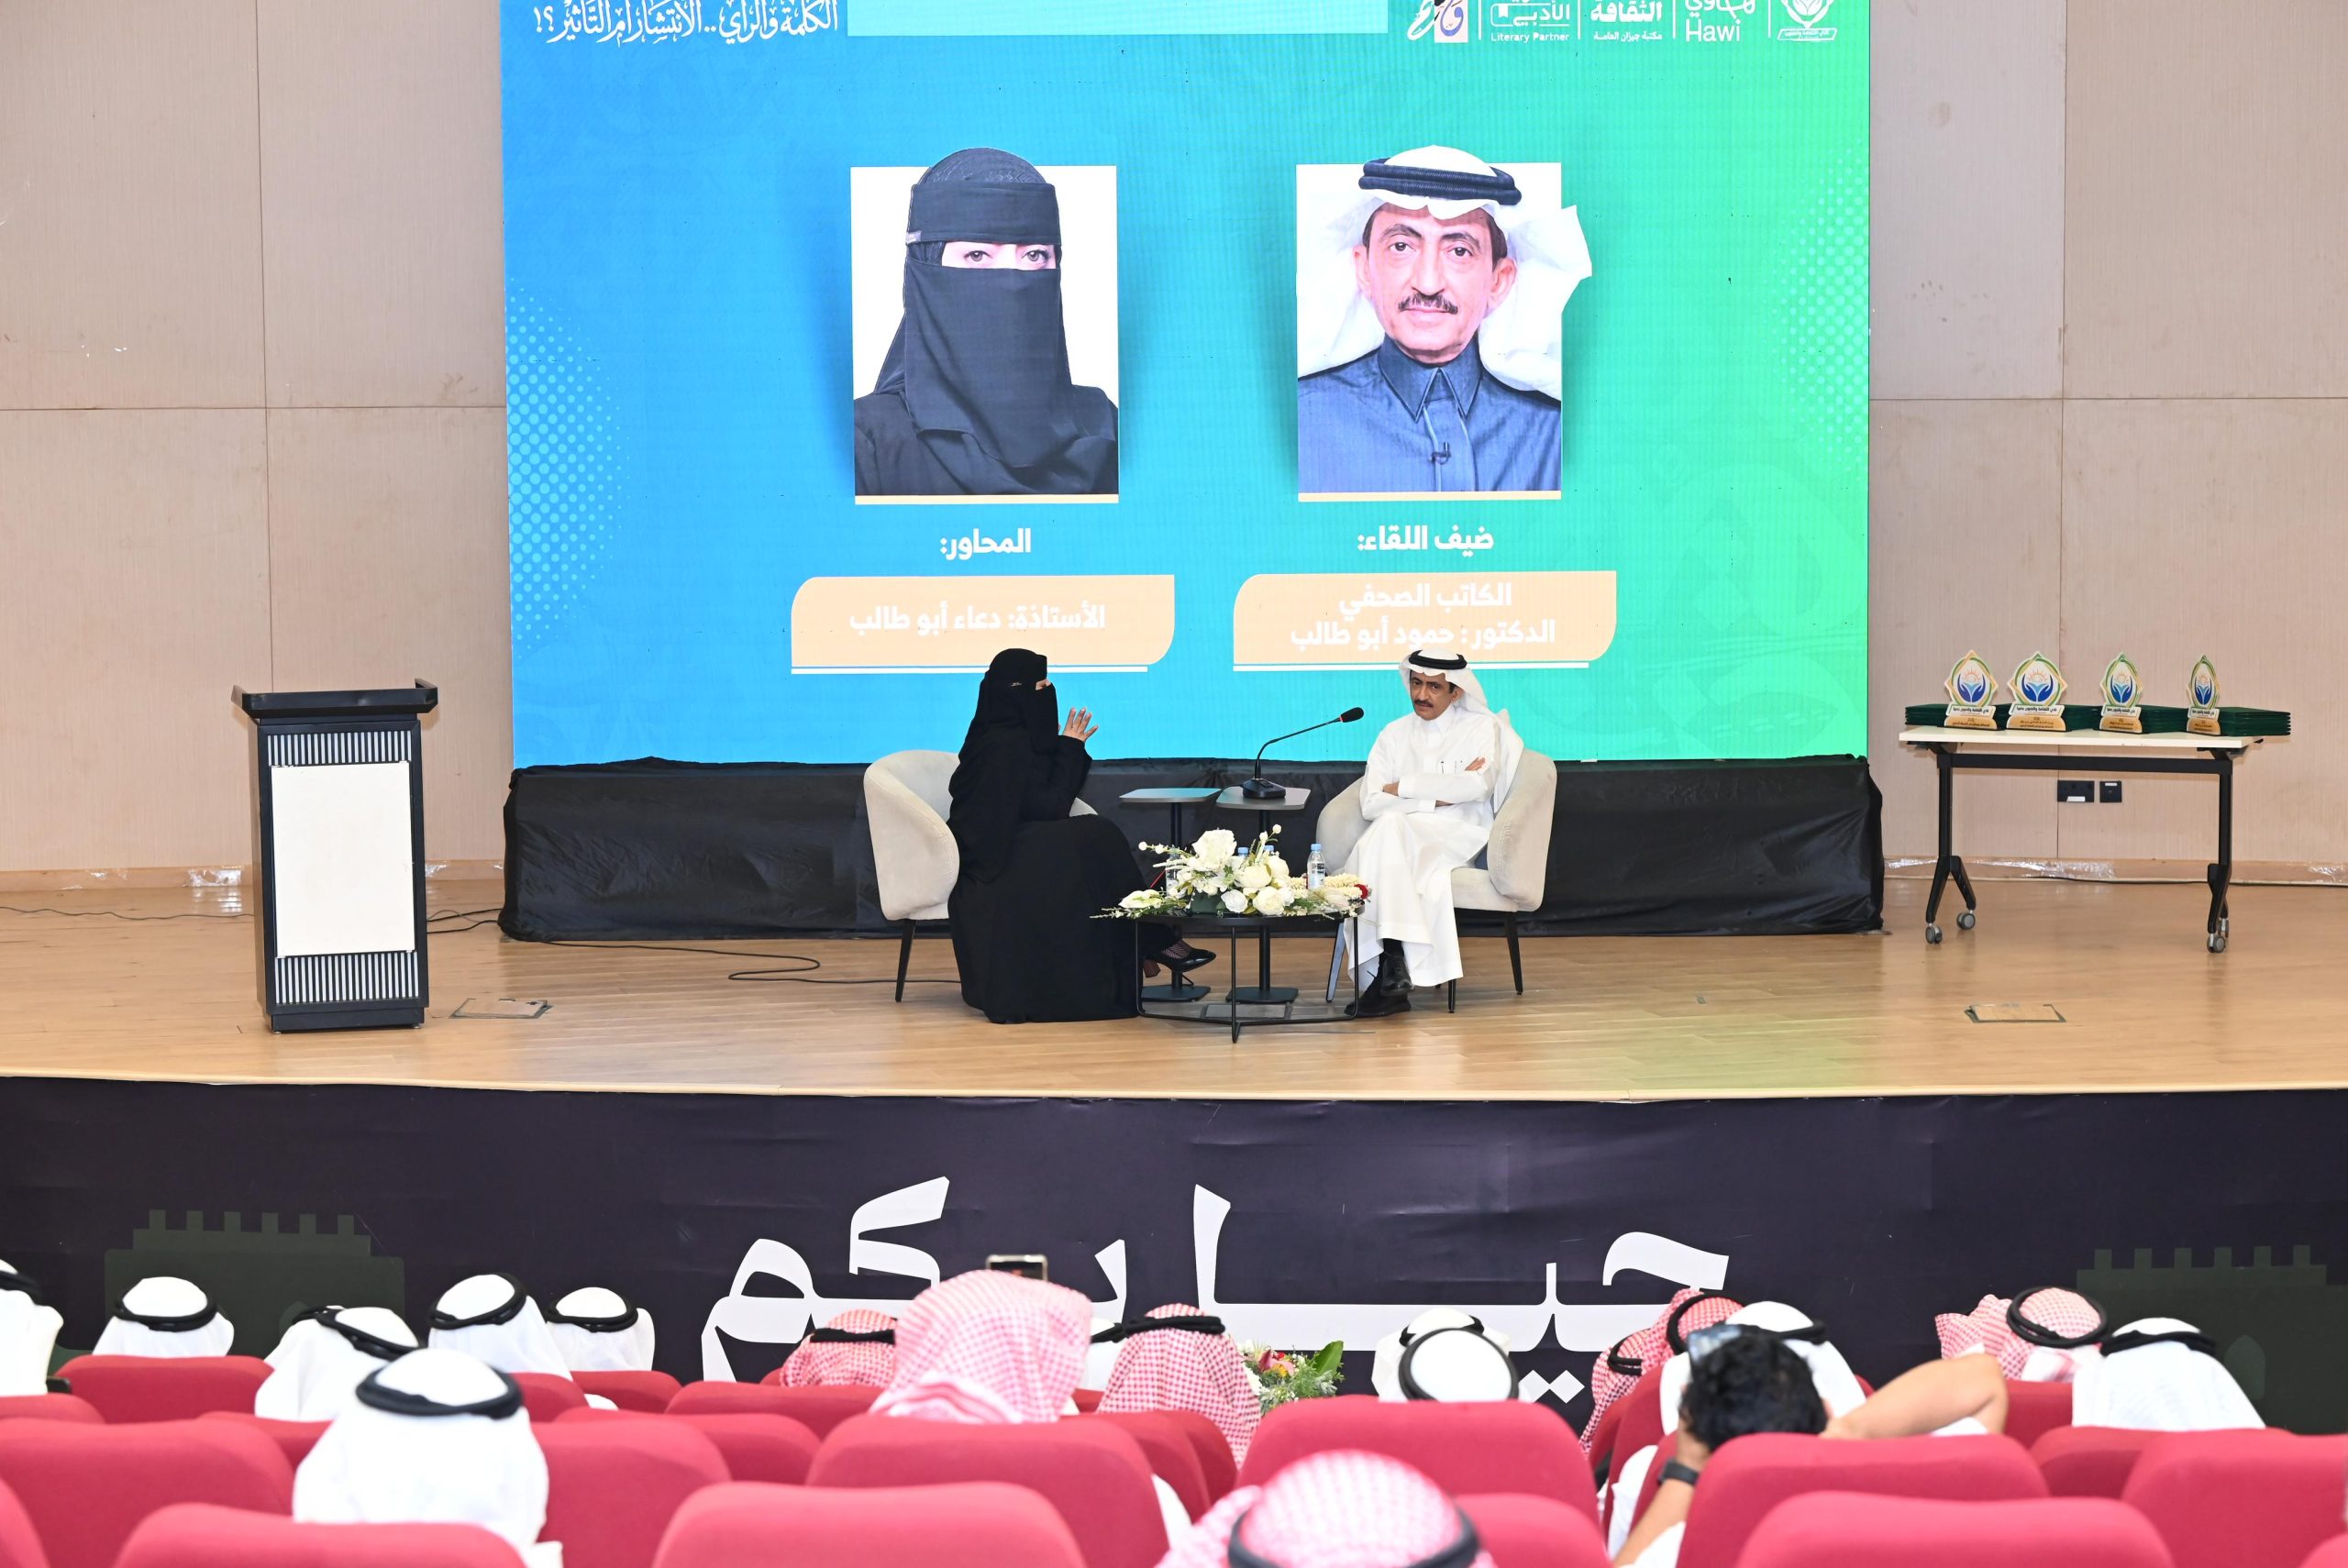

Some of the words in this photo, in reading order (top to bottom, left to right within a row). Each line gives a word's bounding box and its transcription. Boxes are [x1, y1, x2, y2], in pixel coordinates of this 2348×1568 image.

[1490, 32, 1531, 43] Literary
[1533, 32, 1570, 41] Partner
[1685, 18, 1742, 42] Hawi
[940, 527, 1031, 560] المحاور:
[1357, 525, 1428, 551] اللقاء:
[1433, 525, 1494, 557] ضيف
[1339, 582, 1431, 621] الصحفي
[1436, 582, 1512, 613] الكاتب
[849, 605, 911, 635] طالب
[917, 601, 947, 635] أبو
[954, 604, 1001, 630] دعاء
[1008, 601, 1105, 630] الأستاذة:
[1290, 621, 1351, 650] طالب
[1357, 615, 1390, 652] أبو
[1393, 625, 1455, 650] حمود
[1471, 619, 1556, 650] الدكتور
